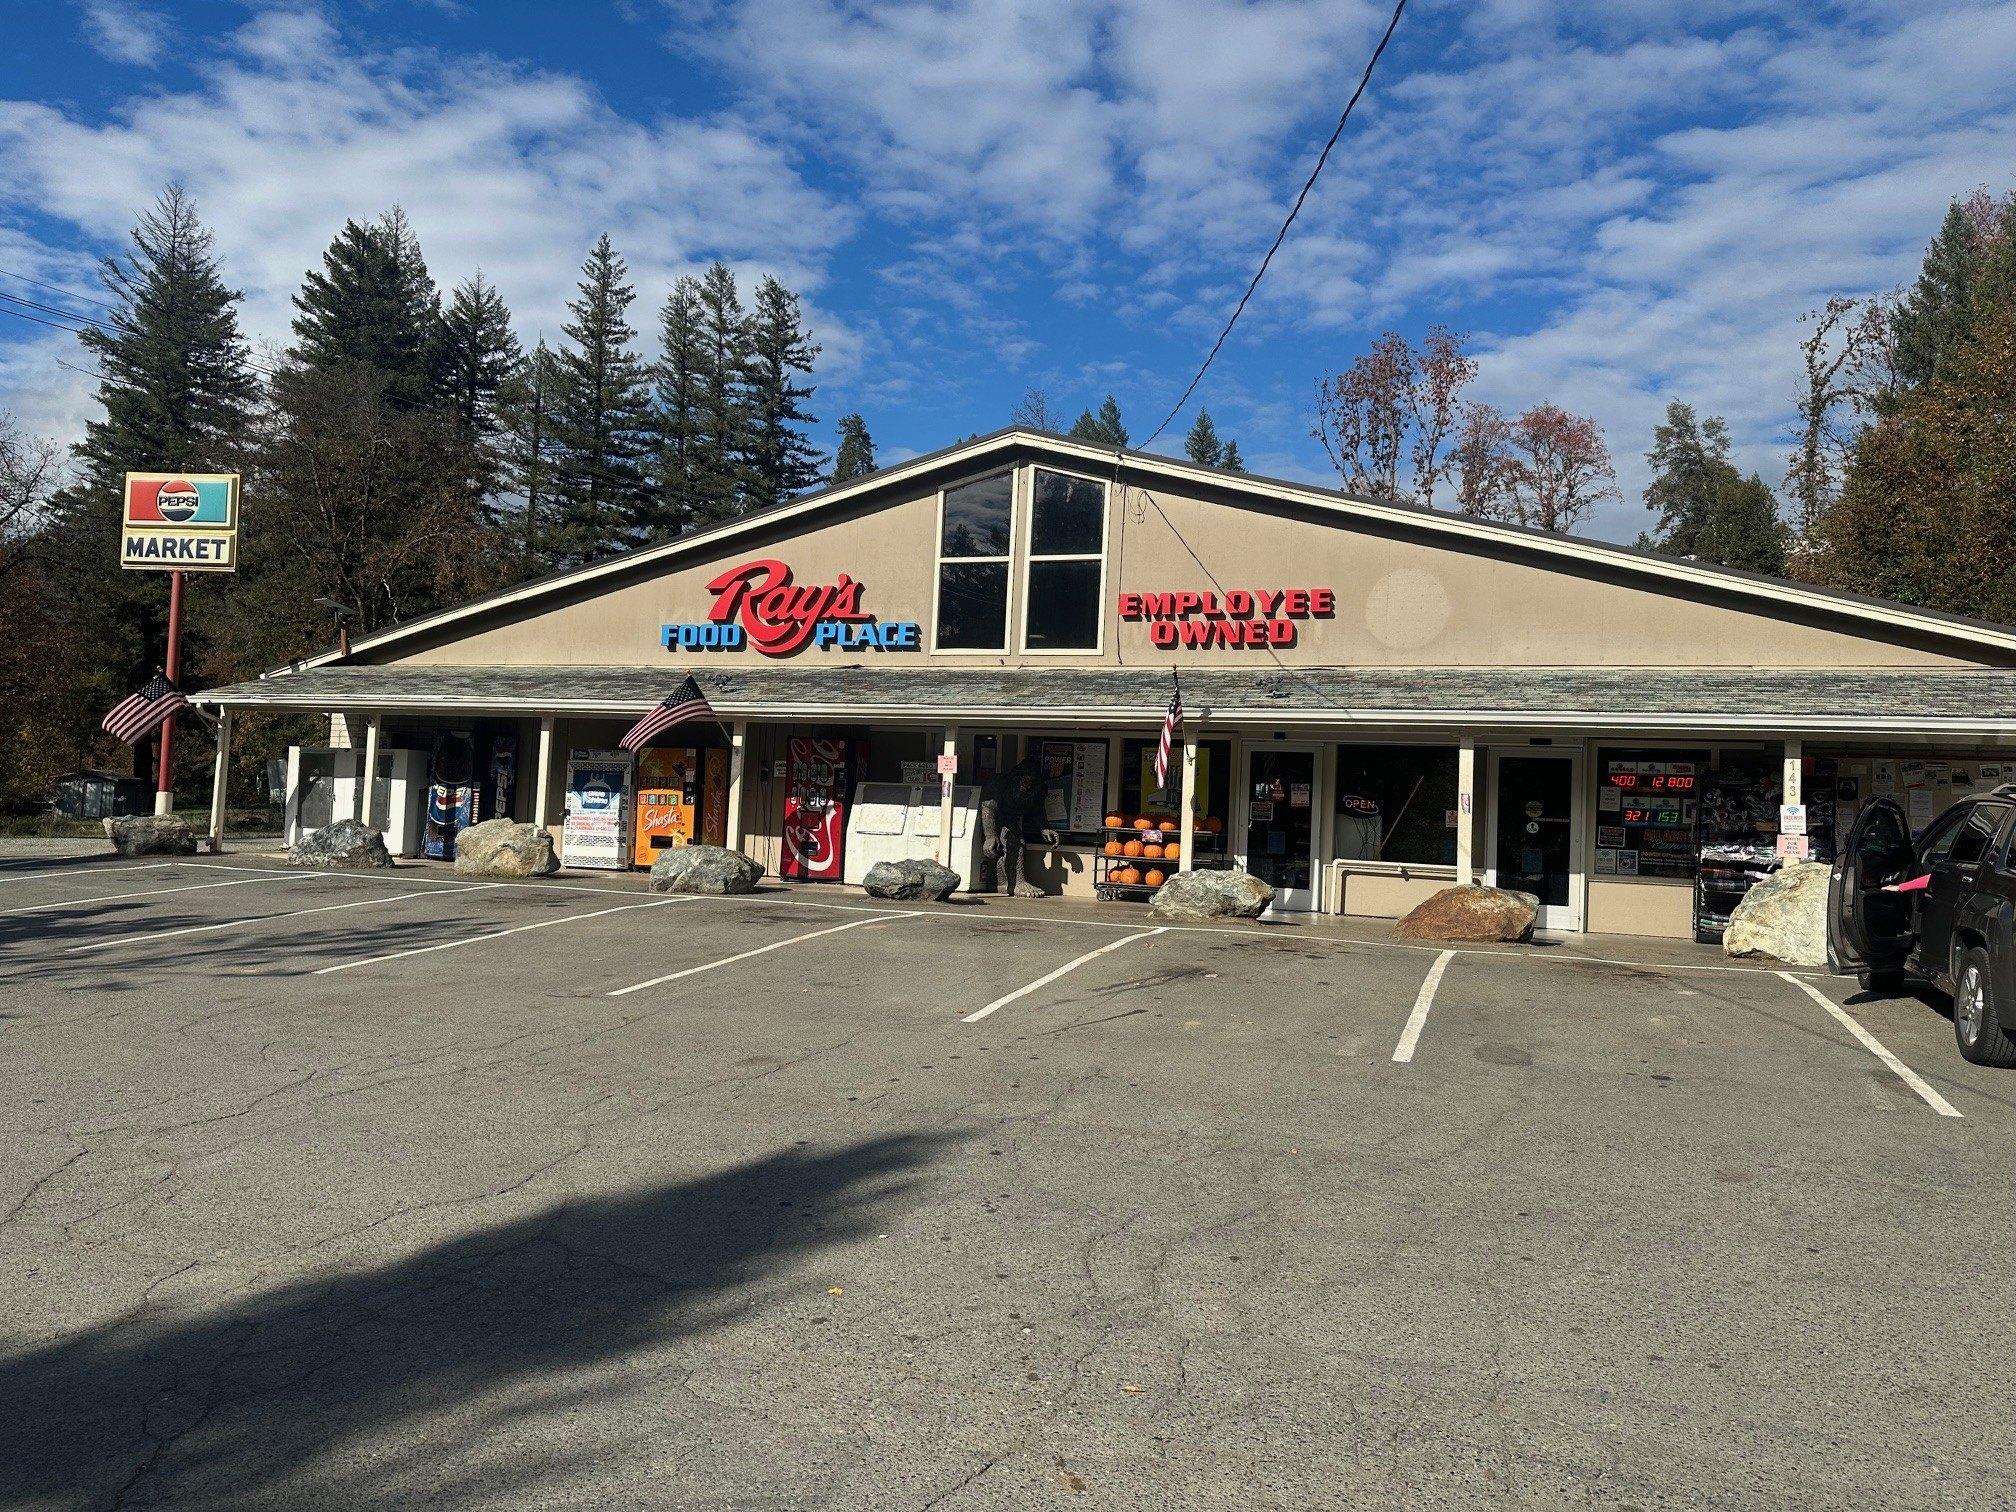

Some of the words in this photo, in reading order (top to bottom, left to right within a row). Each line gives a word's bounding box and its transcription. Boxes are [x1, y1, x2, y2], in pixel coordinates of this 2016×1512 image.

[159, 496, 199, 507] PEPSI
[126, 537, 227, 560] MARKET
[704, 559, 874, 656] Ray's
[1119, 588, 1335, 619] EMPLOYEE
[661, 624, 745, 650] FOOD
[815, 622, 919, 650] PLACE
[1150, 619, 1296, 648] OWNED
[1611, 775, 1636, 786] 400
[1652, 776, 1664, 787] 12
[1667, 777, 1694, 788] 800
[1789, 760, 1797, 797] 143
[1345, 799, 1376, 809] OPEN
[1625, 810, 1650, 821] 321
[1658, 811, 1679, 823] 153
[643, 806, 680, 831] Shasta
